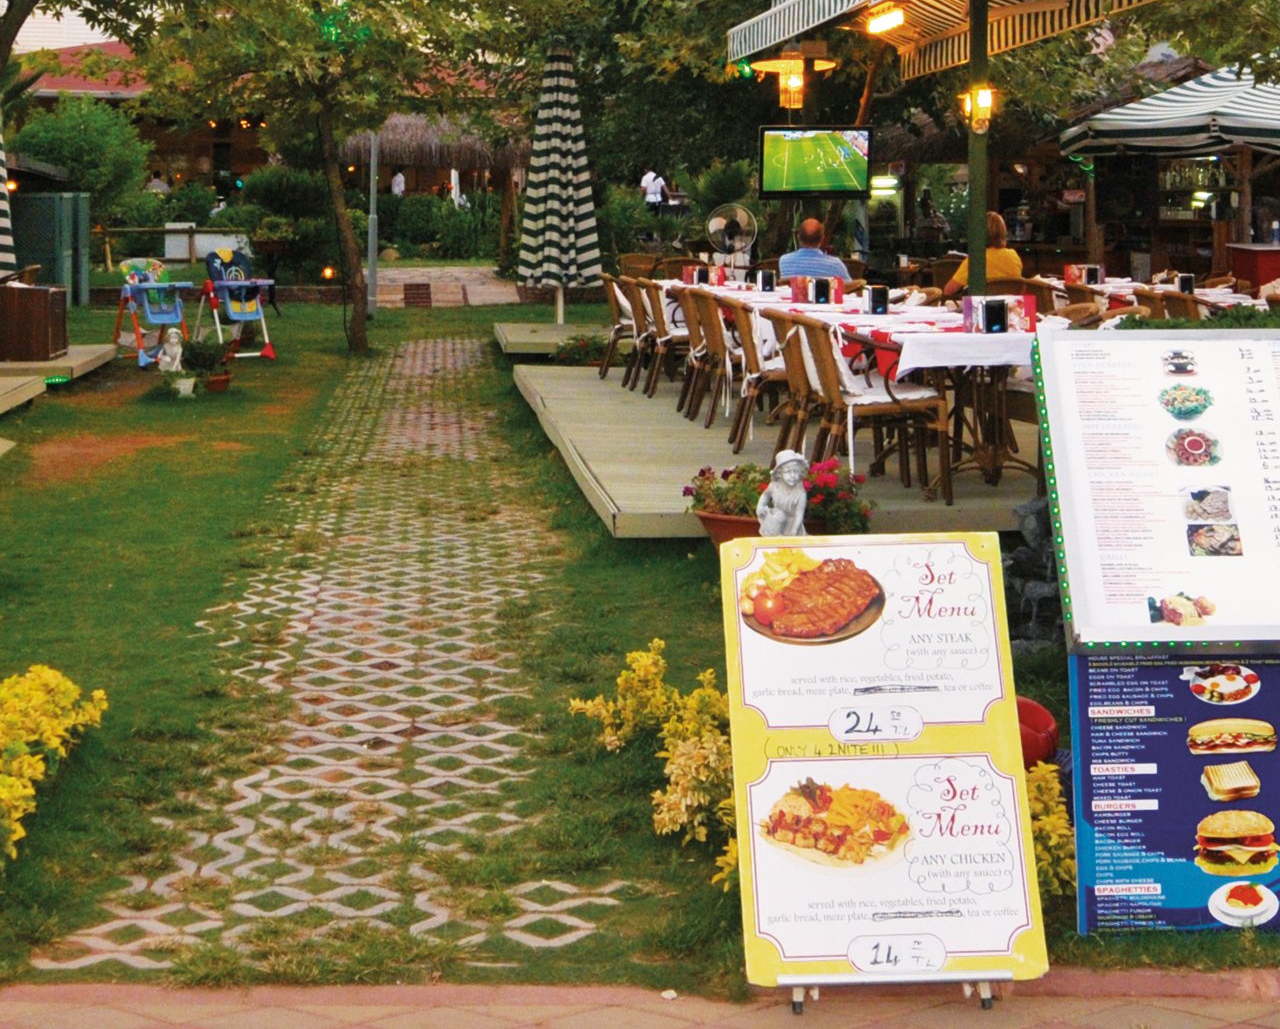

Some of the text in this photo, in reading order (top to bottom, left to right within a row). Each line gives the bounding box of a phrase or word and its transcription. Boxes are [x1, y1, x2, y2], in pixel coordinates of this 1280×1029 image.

[913, 561, 956, 585] Set
[898, 587, 977, 619] Menu
[909, 633, 973, 644] ANY STEAK
[1090, 706, 1152, 715] SANDWICHES
[844, 710, 883, 736] 24
[776, 744, 807, 757] ONLY
[814, 744, 822, 756] 4
[934, 775, 979, 801] Set
[919, 804, 1001, 838] Menu
[921, 853, 1006, 866] ANY CHICKEN
[1096, 886, 1159, 894] SPAGHETTIES
[869, 942, 901, 966] 14
